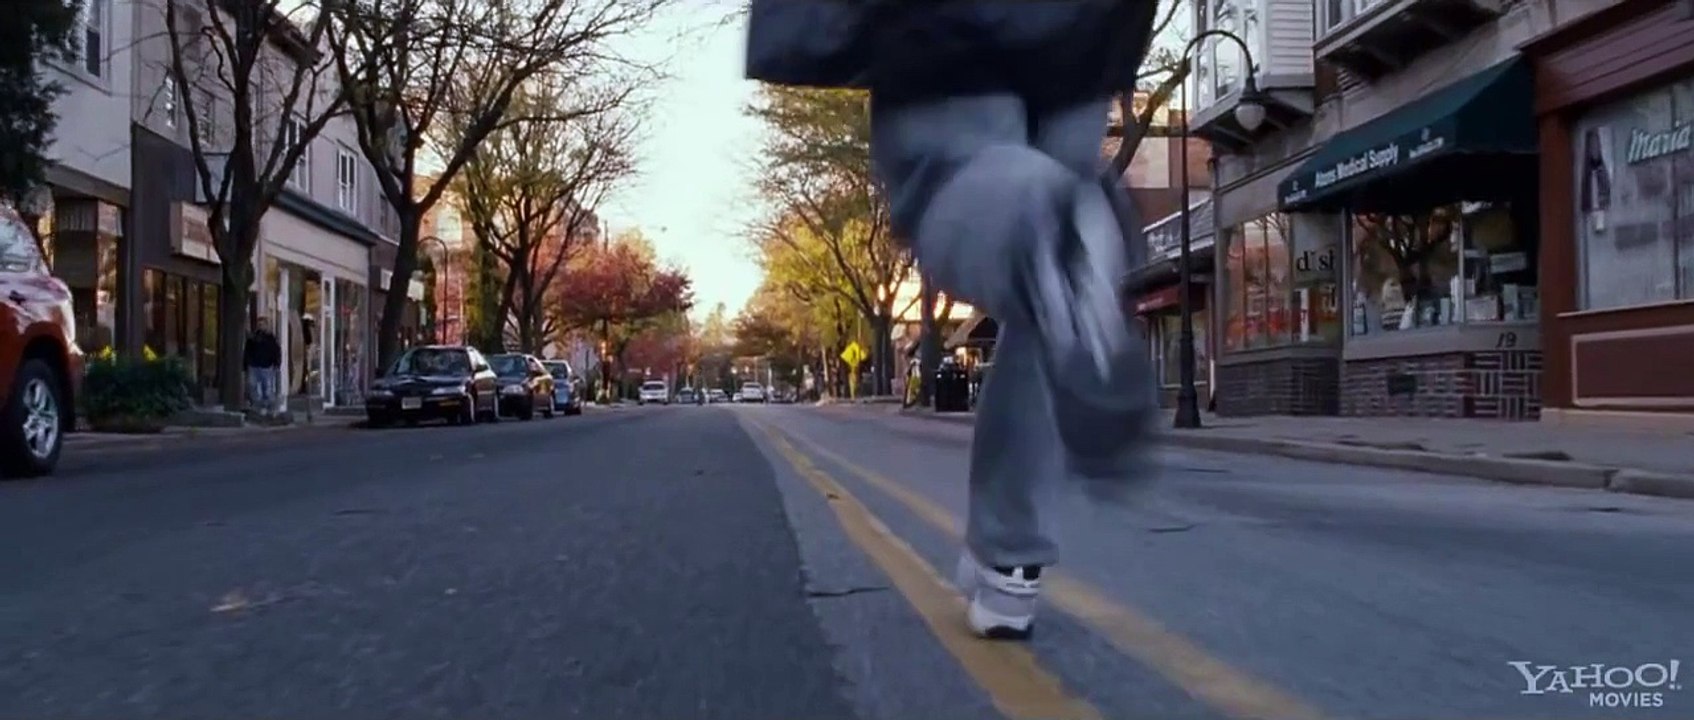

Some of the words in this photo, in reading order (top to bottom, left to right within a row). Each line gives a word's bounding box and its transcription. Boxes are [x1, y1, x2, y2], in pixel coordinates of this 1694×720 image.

[1336, 151, 1368, 180] Medical
[1369, 142, 1399, 168] Supply
[1296, 249, 1336, 272] dsh
[1496, 331, 1517, 348] 19
